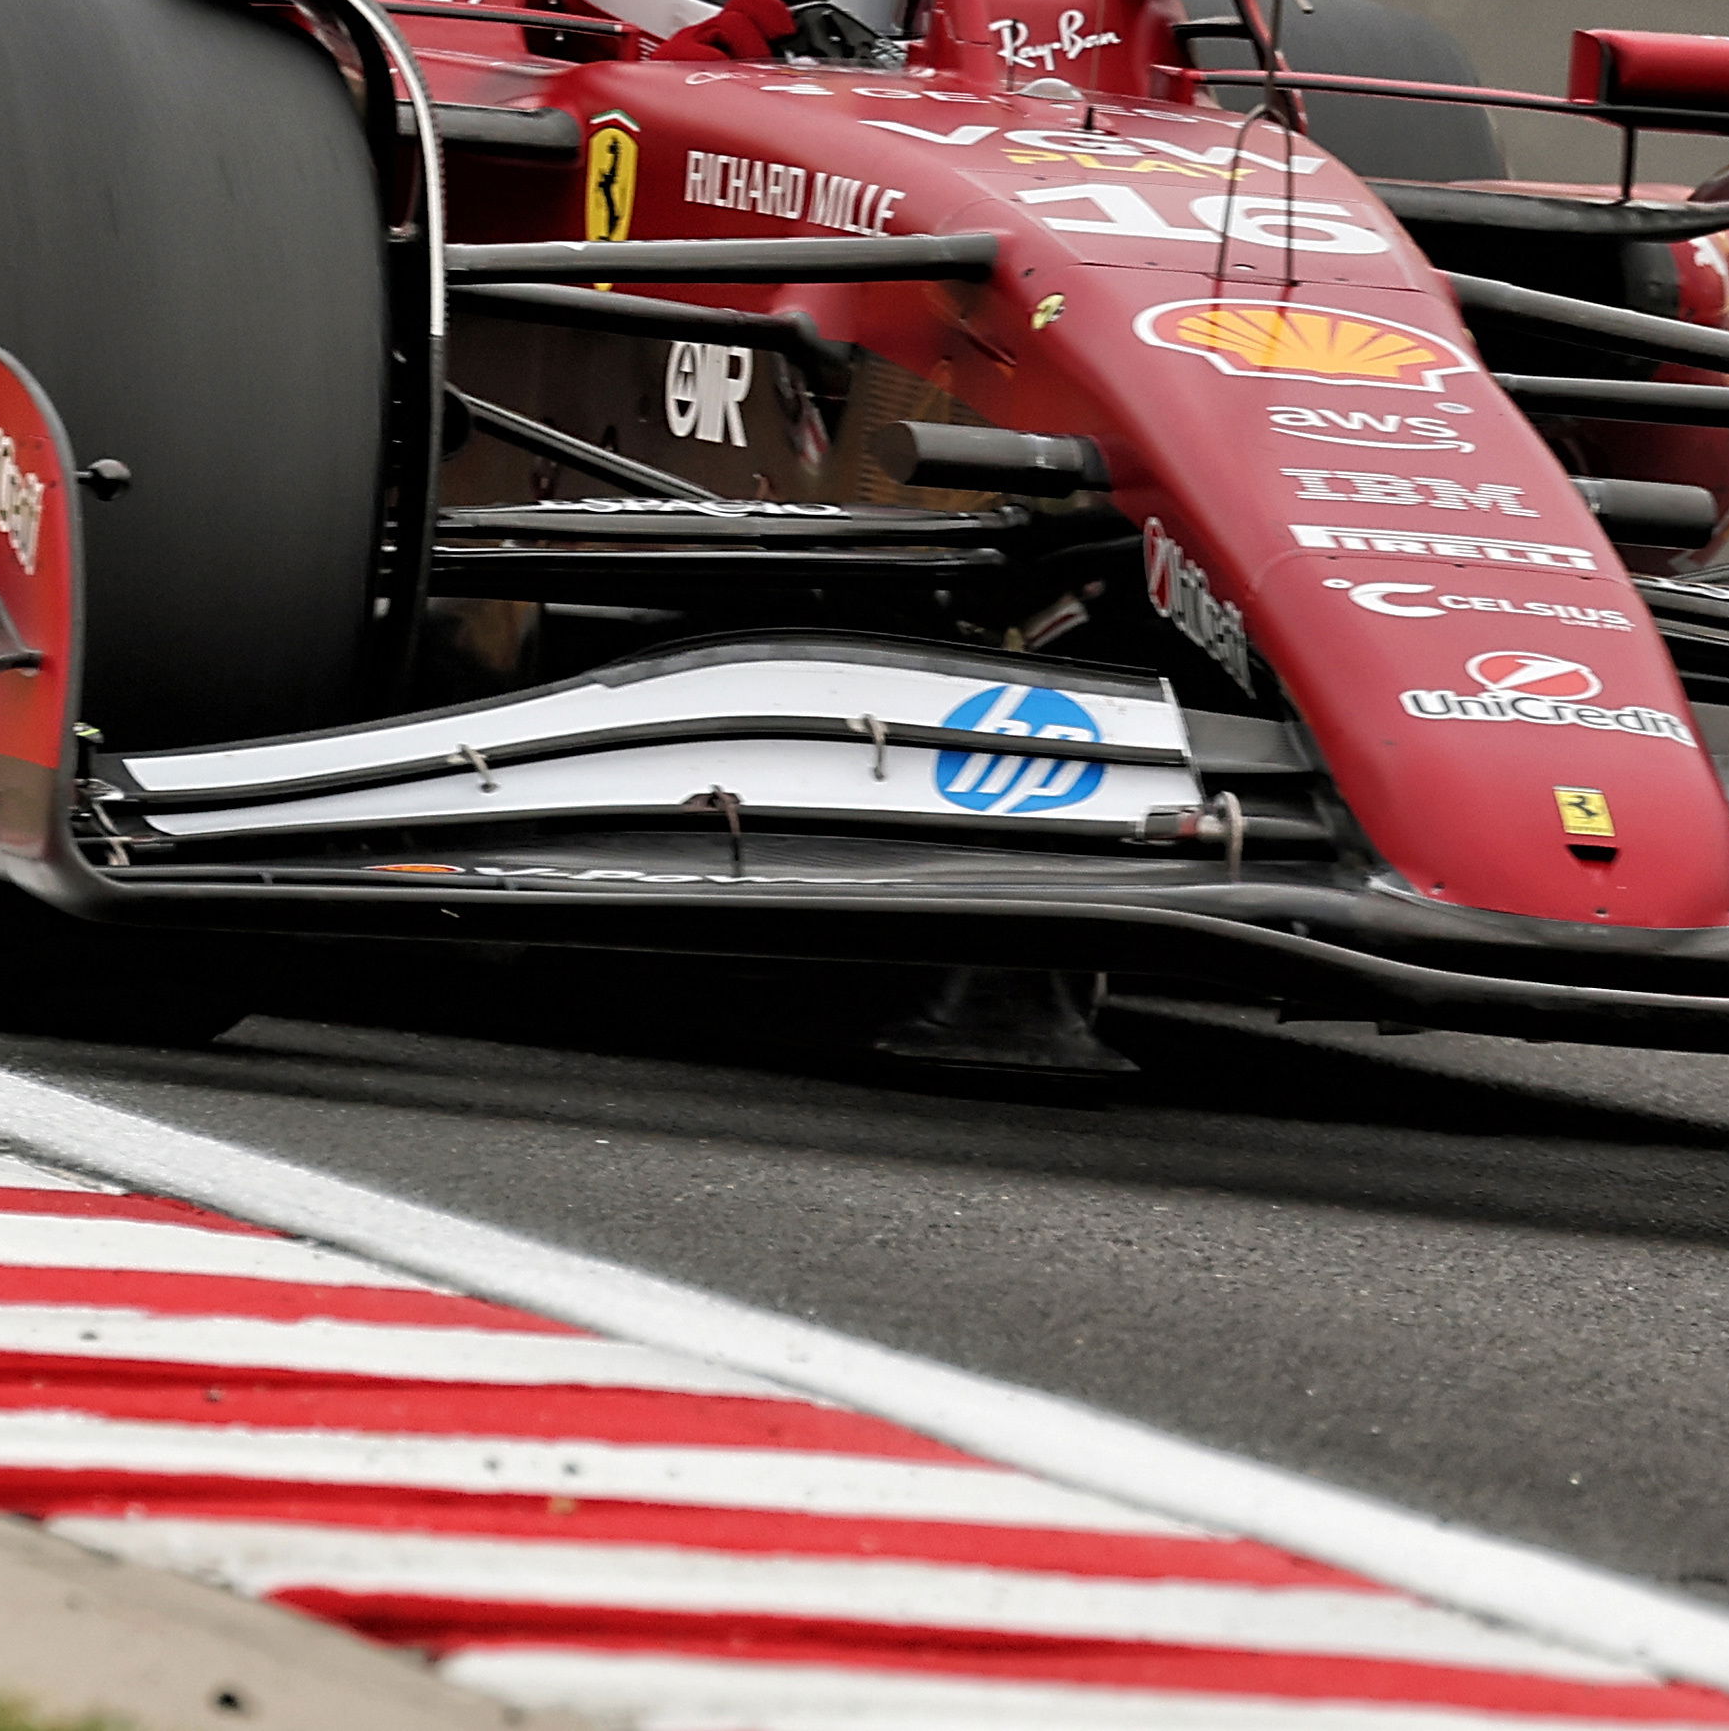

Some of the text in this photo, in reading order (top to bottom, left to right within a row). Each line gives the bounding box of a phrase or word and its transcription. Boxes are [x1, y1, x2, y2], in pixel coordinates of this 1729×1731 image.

[987, 9, 1121, 71] Ray-Ban
[858, 119, 1328, 175] VGW
[1000, 148, 1258, 181] PLAY
[683, 150, 907, 238] RICHARD MILLE
[1014, 182, 1391, 255] 16
[1265, 405, 1460, 439] aws
[1278, 467, 1542, 519] IBM
[1287, 523, 1599, 570] PIRELLI
[1436, 594, 1635, 628] CELSIUS
[1399, 688, 1698, 748] UniCredit
[943, 685, 1098, 813] hp
